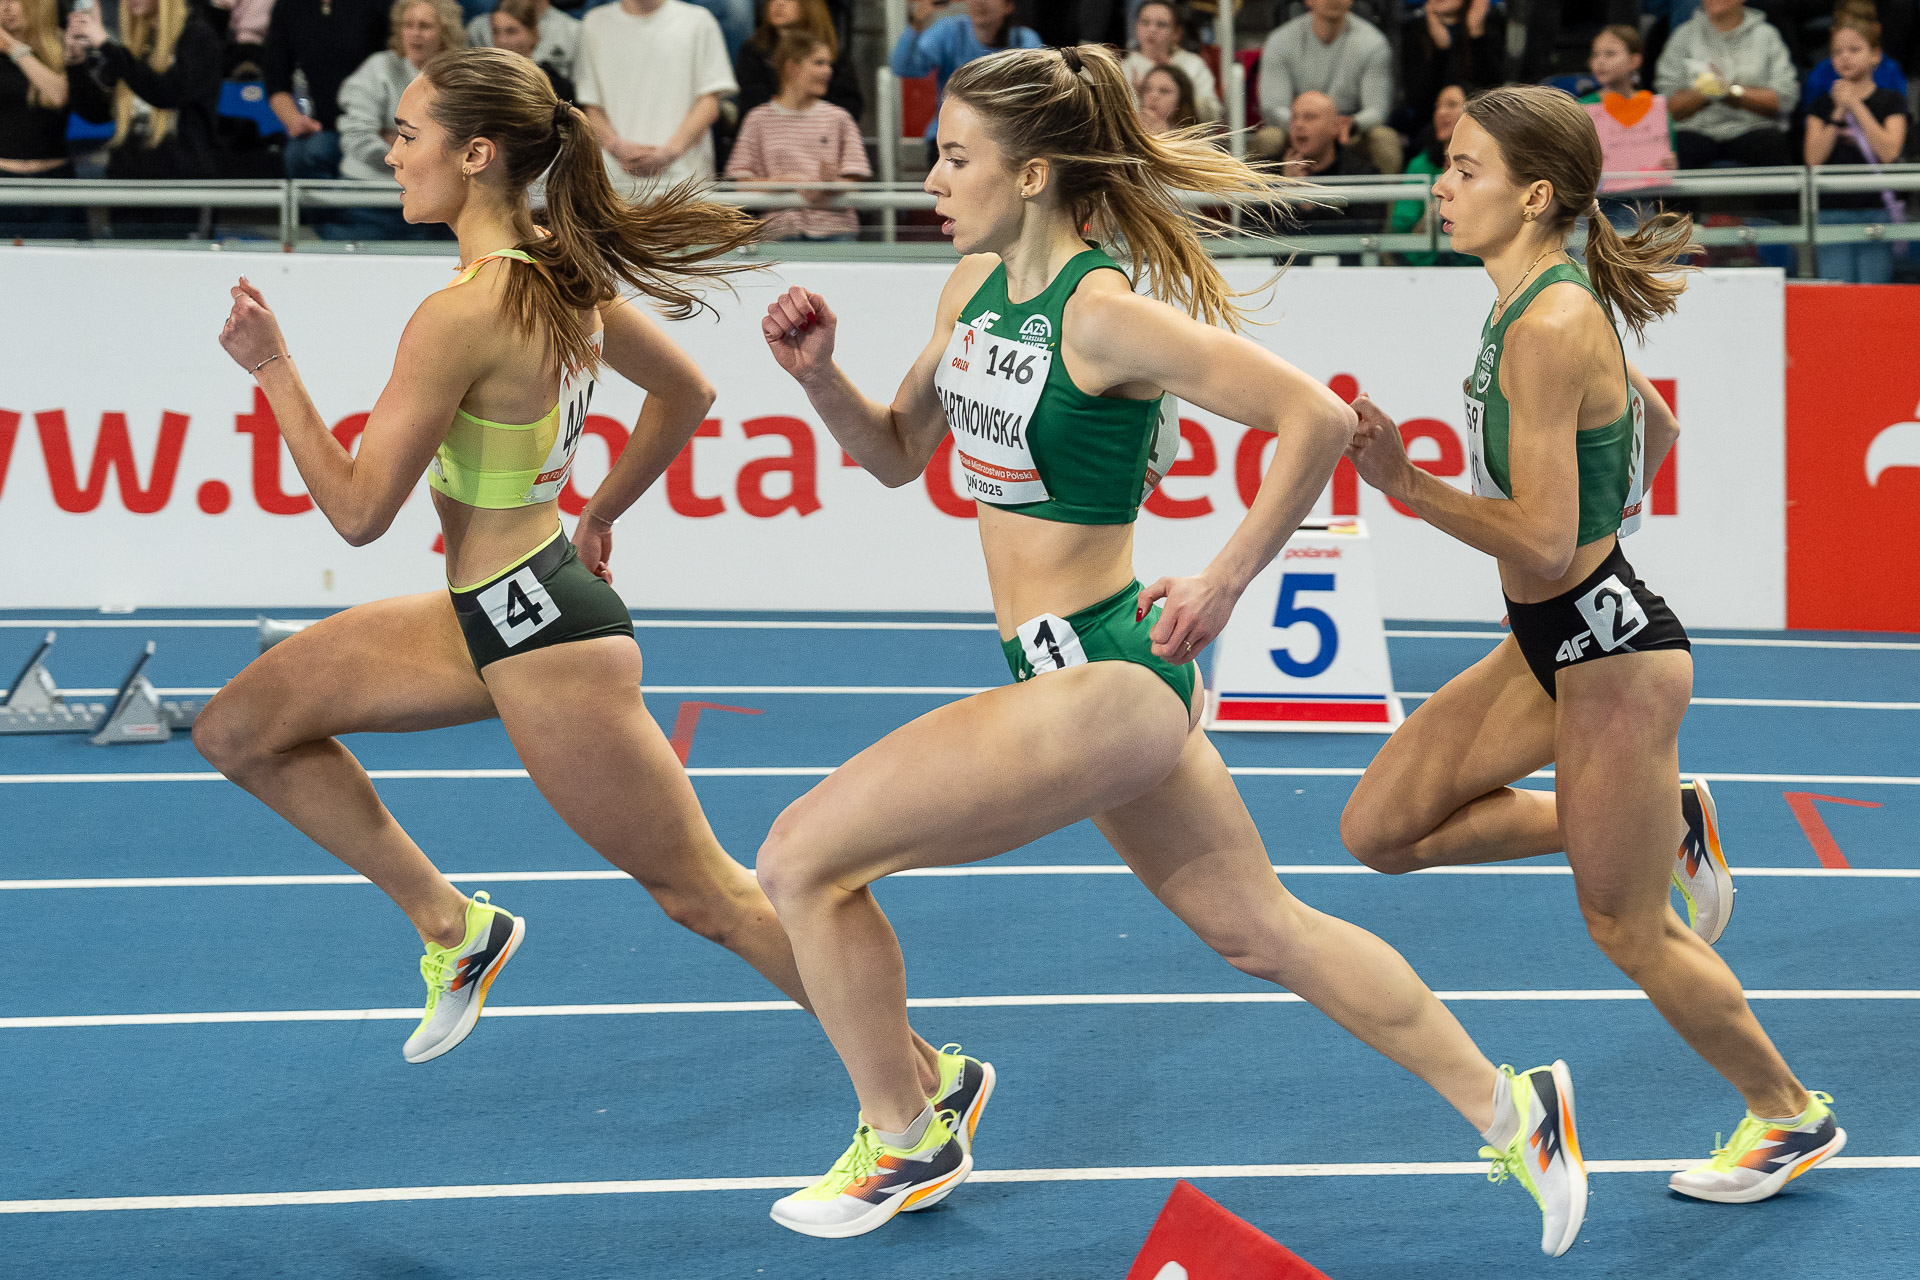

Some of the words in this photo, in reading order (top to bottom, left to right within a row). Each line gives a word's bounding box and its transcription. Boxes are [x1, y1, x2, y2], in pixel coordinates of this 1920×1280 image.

[1027, 322, 1047, 337] AZS
[986, 344, 1037, 385] 146
[978, 480, 1003, 497] 2025
[1006, 470, 1034, 480] Polski
[507, 579, 544, 629] 4
[1594, 587, 1640, 642] 2
[1033, 619, 1066, 670] 1
[1269, 573, 1339, 678] 5
[1555, 629, 1591, 662] 4F
